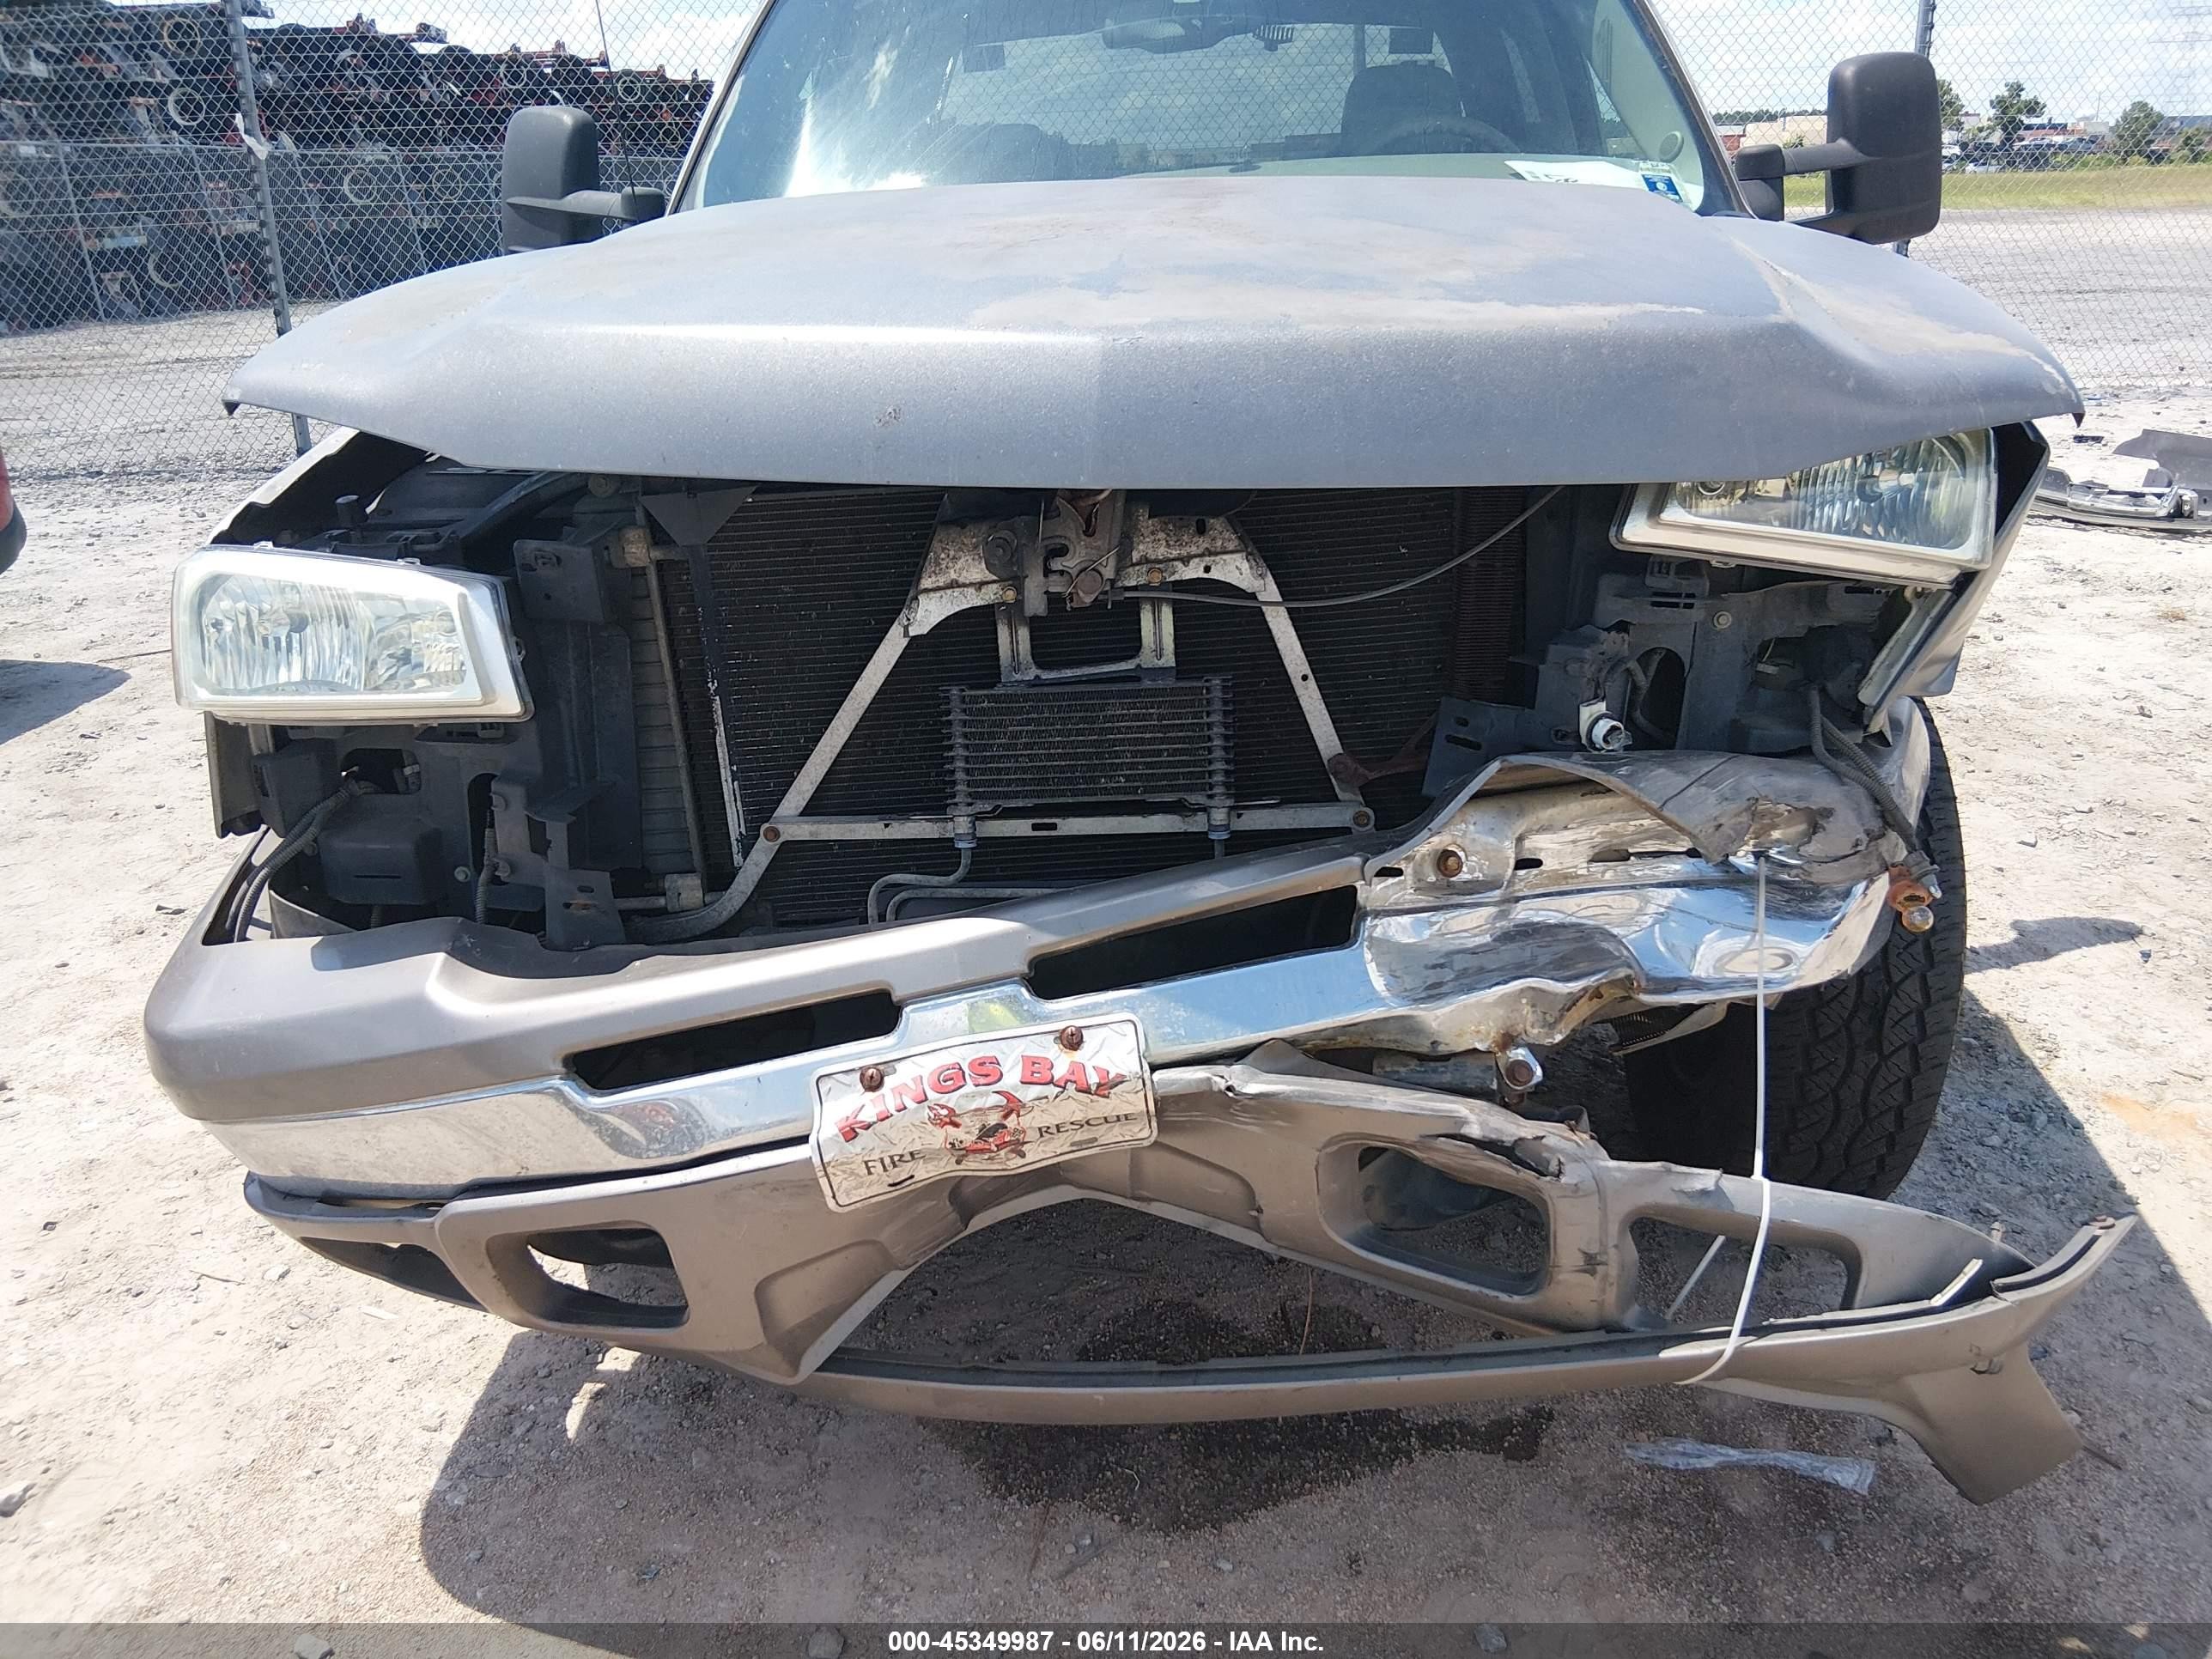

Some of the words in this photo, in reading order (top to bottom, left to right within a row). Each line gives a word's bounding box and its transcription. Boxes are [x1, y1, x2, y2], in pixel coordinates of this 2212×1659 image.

[836, 1055, 1004, 1142] KINGS
[1021, 1054, 1127, 1098] BAY
[863, 1150, 927, 1176] FIRE
[1037, 1113, 1138, 1138] RESCUE
